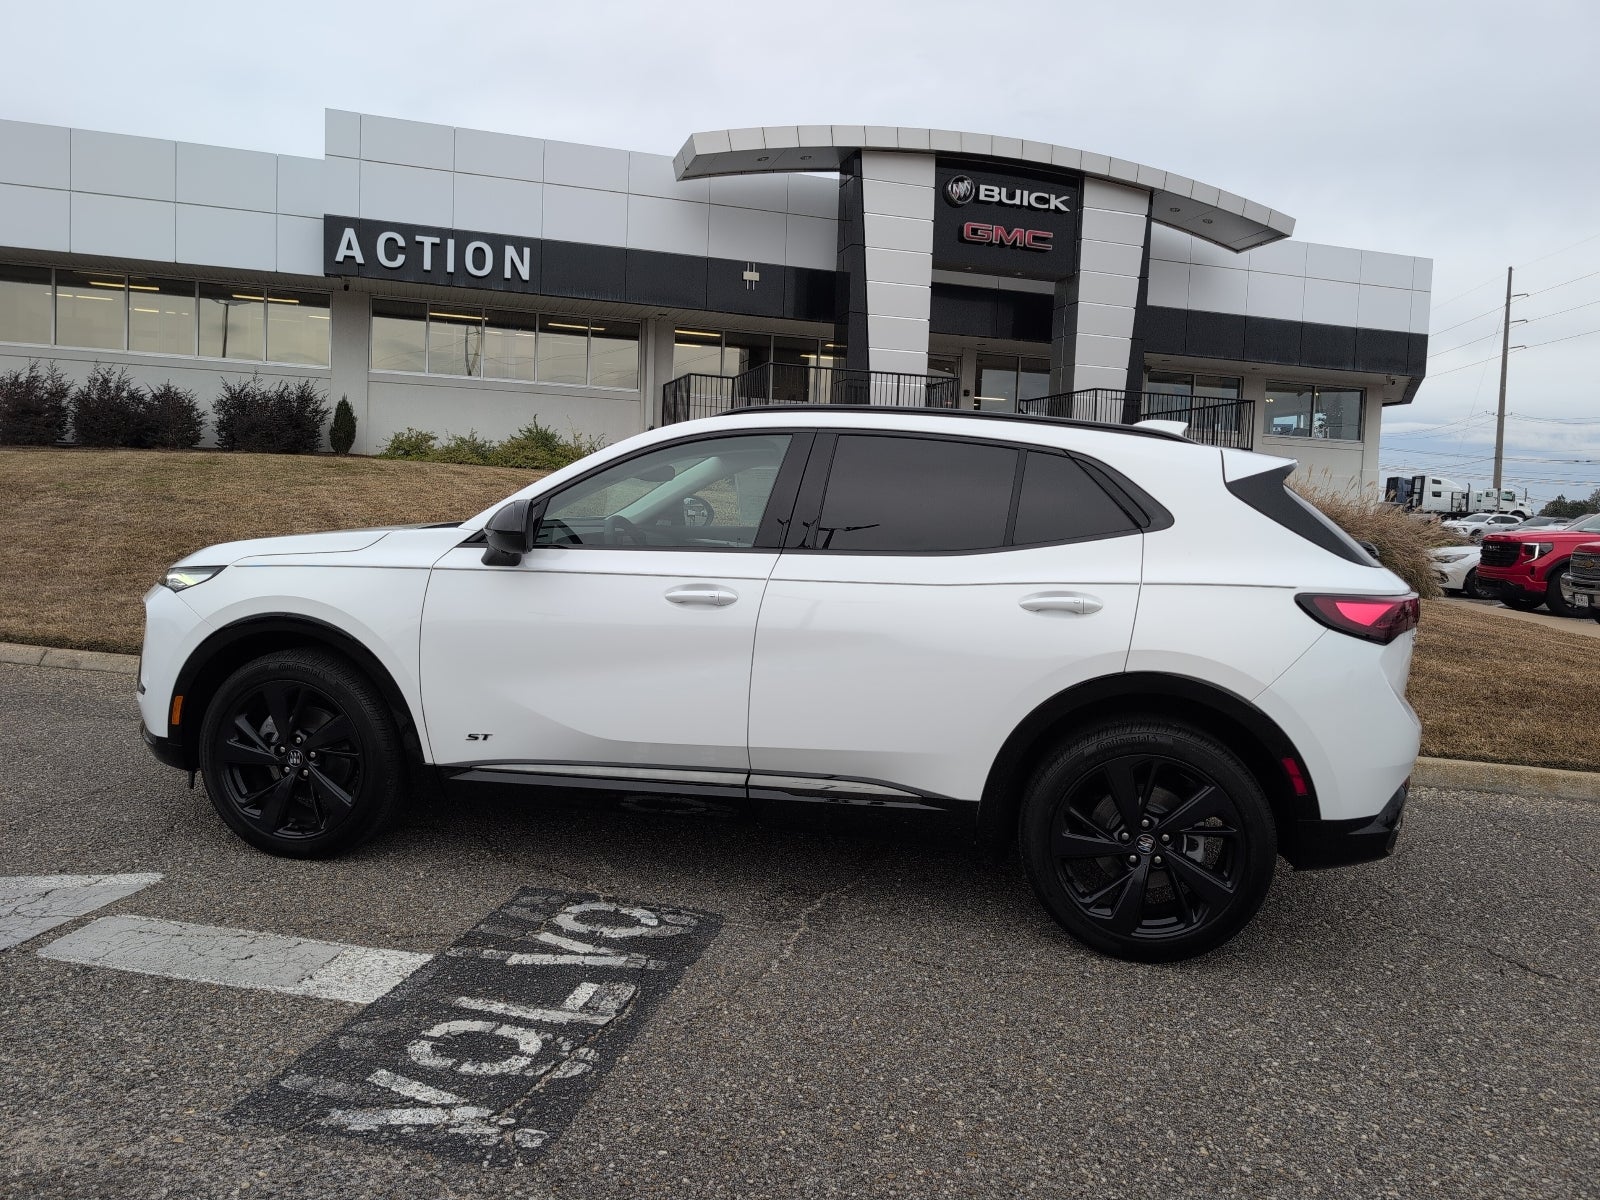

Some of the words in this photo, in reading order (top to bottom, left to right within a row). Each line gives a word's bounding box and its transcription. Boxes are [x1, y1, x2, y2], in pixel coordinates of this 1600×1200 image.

[979, 184, 1071, 212] BUICK
[963, 221, 1054, 250] GMC
[334, 227, 531, 281] ACTION
[465, 733, 494, 741] ST
